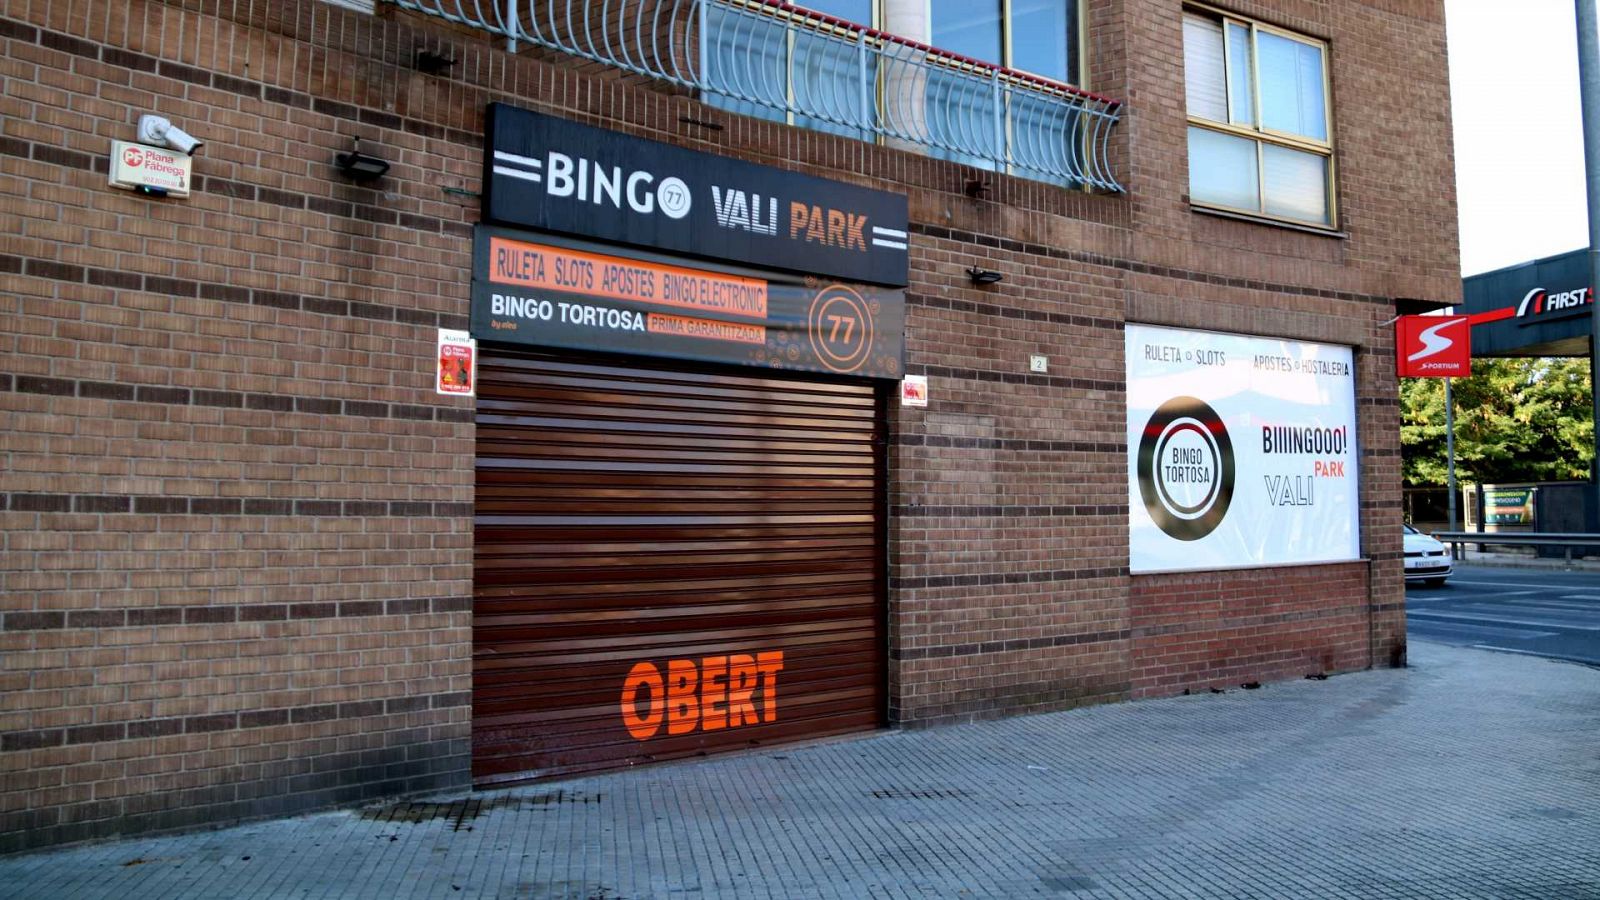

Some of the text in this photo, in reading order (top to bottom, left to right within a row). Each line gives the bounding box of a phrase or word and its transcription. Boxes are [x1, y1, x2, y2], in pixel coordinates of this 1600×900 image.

[145, 150, 174, 163] Plana
[547, 151, 868, 252] BINGO VALI PARK
[667, 190, 682, 205] 77
[497, 247, 546, 283] RULETA
[555, 256, 593, 289] SLOTS
[601, 265, 655, 298] APOSTES
[663, 273, 698, 303] BINGO
[1547, 288, 1587, 311] FIRST
[491, 293, 646, 332] BINGO TORTOSA
[652, 316, 685, 333] PRIMA
[827, 314, 855, 344] 77
[1036, 360, 1042, 368] 2
[1145, 344, 1350, 376] RULETA SLOTS APOSTES HOSTALERIA
[1172, 447, 1203, 465] BINGO
[1165, 466, 1210, 483] TORTOSA
[1314, 461, 1345, 477] PARK
[1264, 475, 1314, 506] VALI
[621, 651, 784, 741] OBERT
